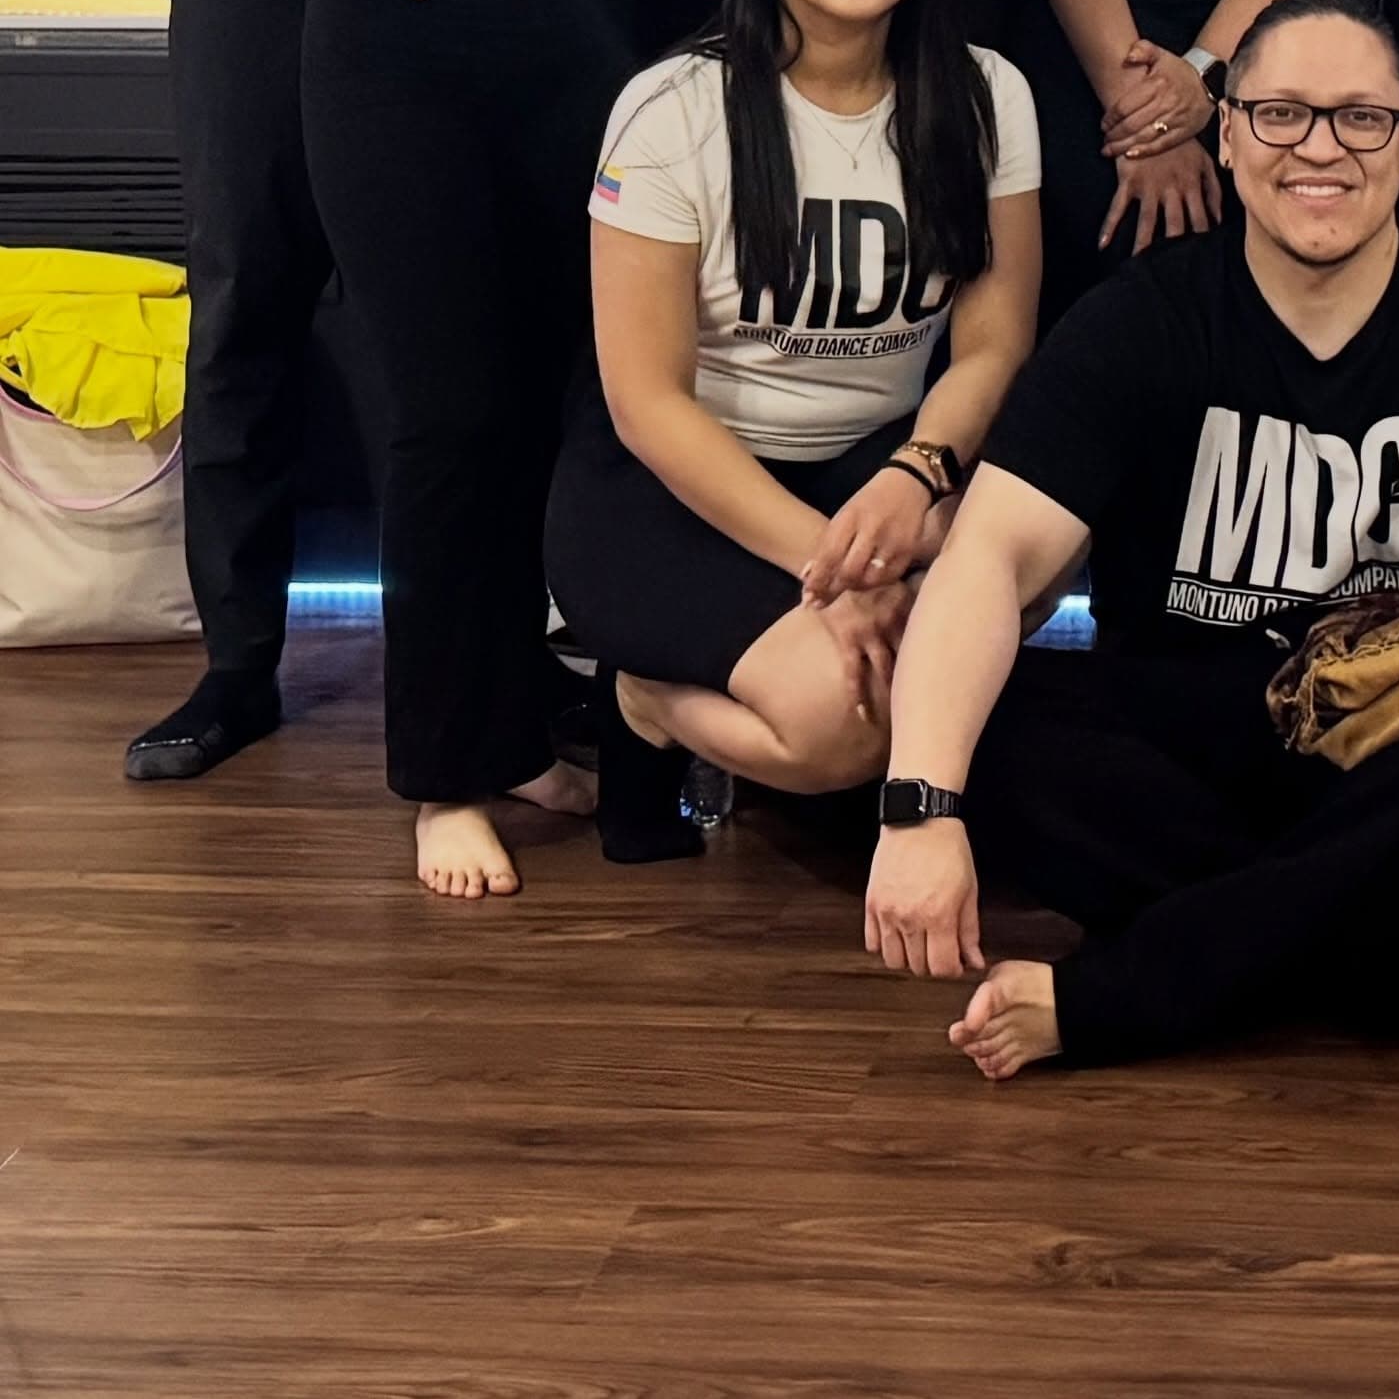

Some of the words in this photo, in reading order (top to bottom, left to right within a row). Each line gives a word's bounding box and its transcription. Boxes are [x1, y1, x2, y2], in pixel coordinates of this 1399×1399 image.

[733, 328, 814, 355] MONTUNO
[815, 336, 873, 357] DANCE
[1166, 581, 1259, 622] MONTUNO
